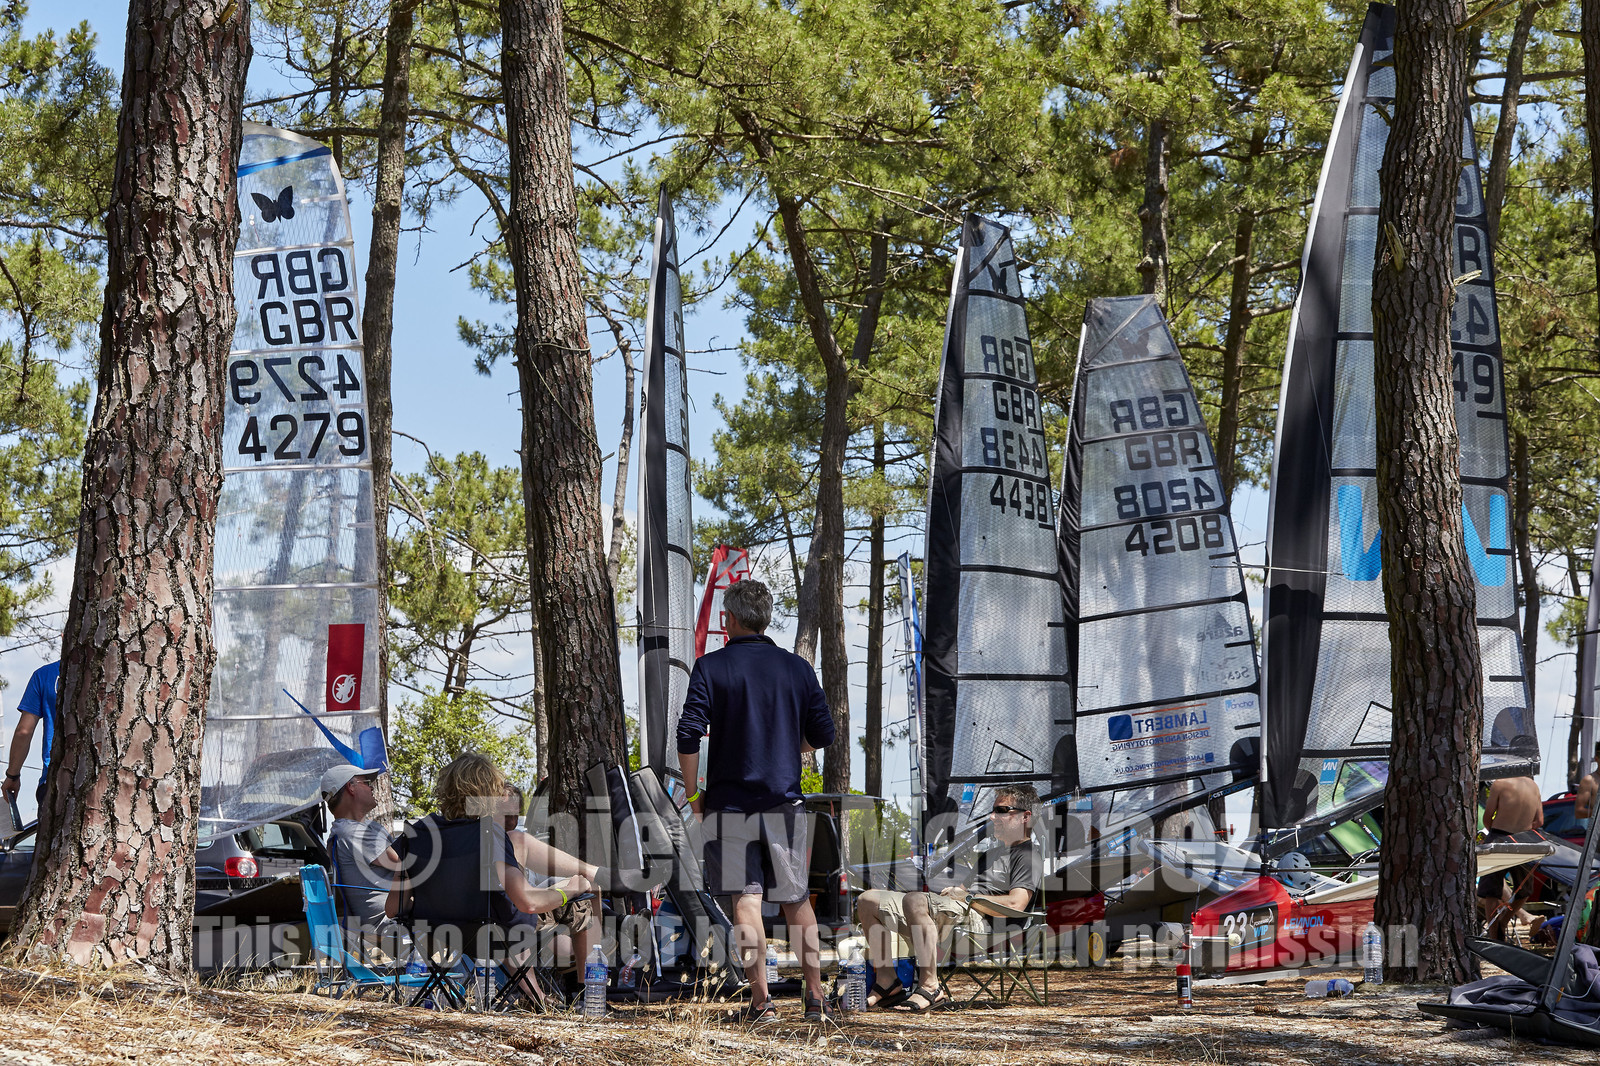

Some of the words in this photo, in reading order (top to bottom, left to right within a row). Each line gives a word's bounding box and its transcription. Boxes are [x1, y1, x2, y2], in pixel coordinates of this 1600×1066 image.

[259, 297, 358, 345] GBR
[992, 382, 1037, 428] GBR
[238, 411, 366, 461] 4279
[1124, 431, 1202, 470] GBR
[989, 475, 1048, 523] 4438
[1125, 514, 1224, 556] 4208
[1223, 911, 1248, 945] 23
[1253, 925, 1269, 938] WIP
